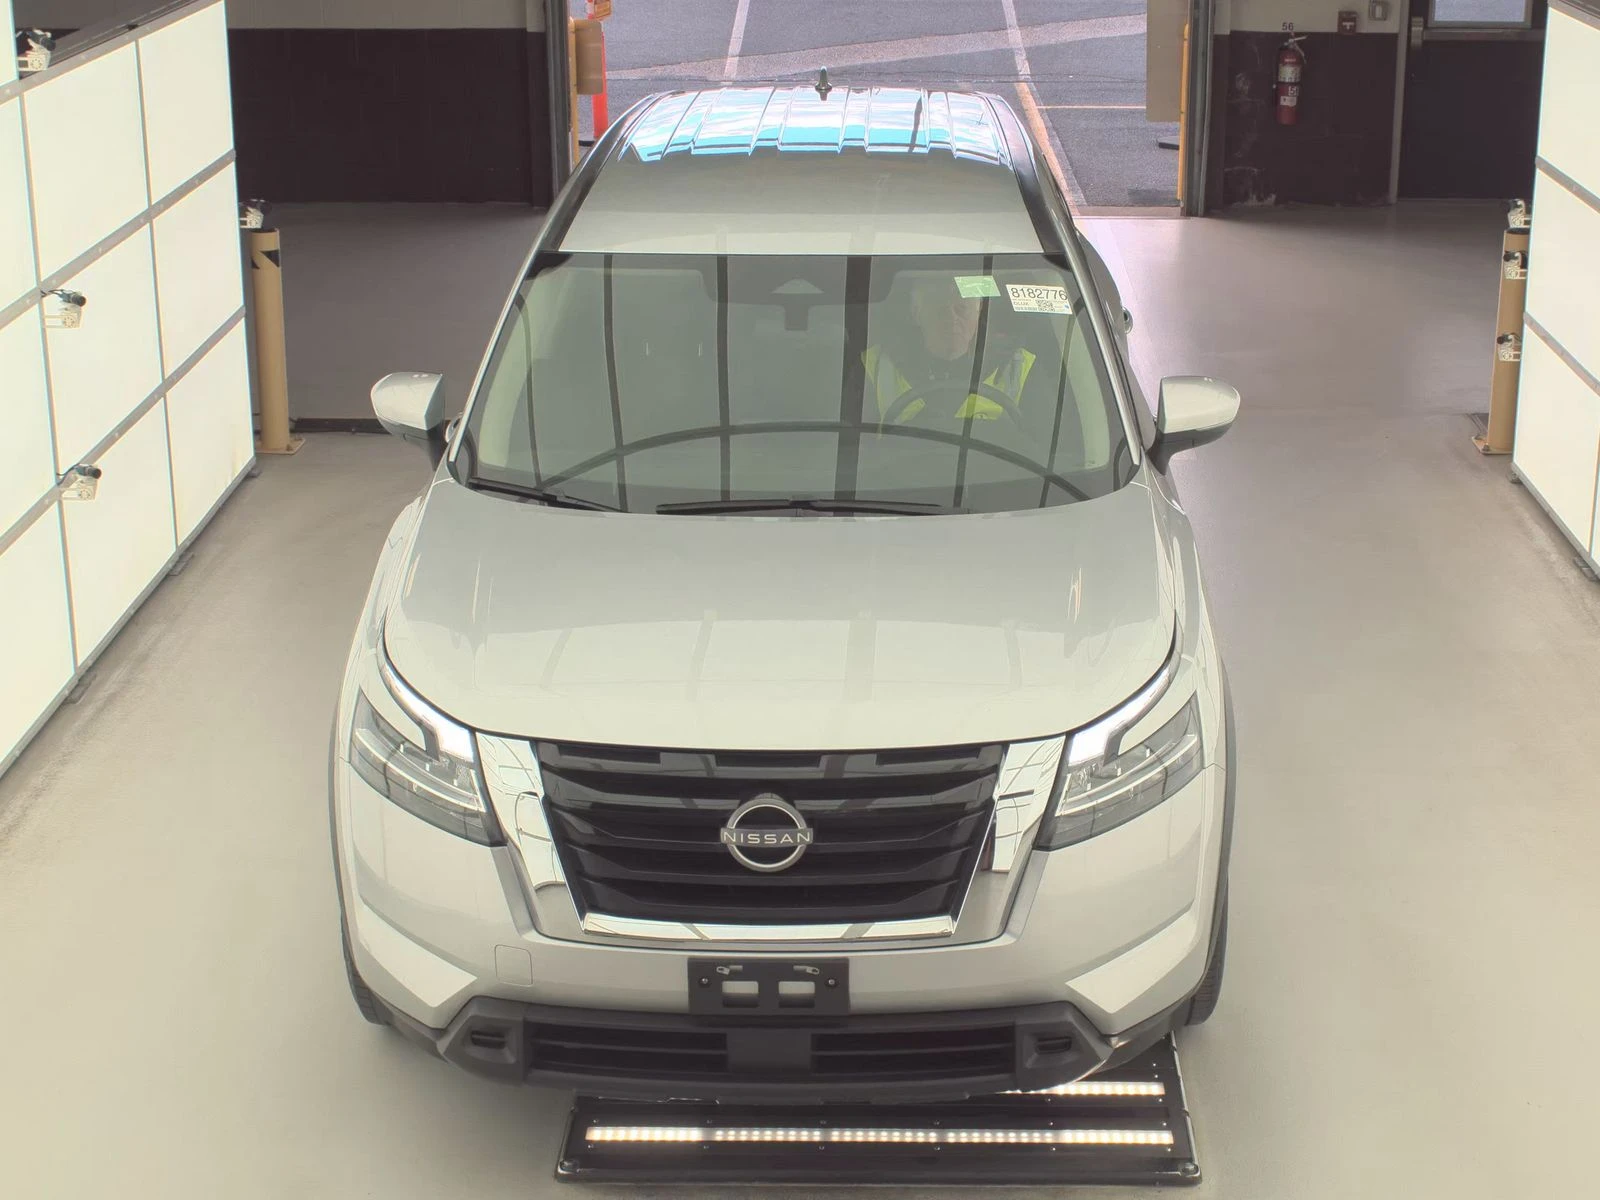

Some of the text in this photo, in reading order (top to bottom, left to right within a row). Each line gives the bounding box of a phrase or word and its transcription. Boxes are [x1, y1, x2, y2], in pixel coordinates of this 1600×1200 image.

[1282, 22, 1294, 31] 56
[1010, 287, 1068, 301] 8182776
[723, 831, 810, 844] NISSAN
